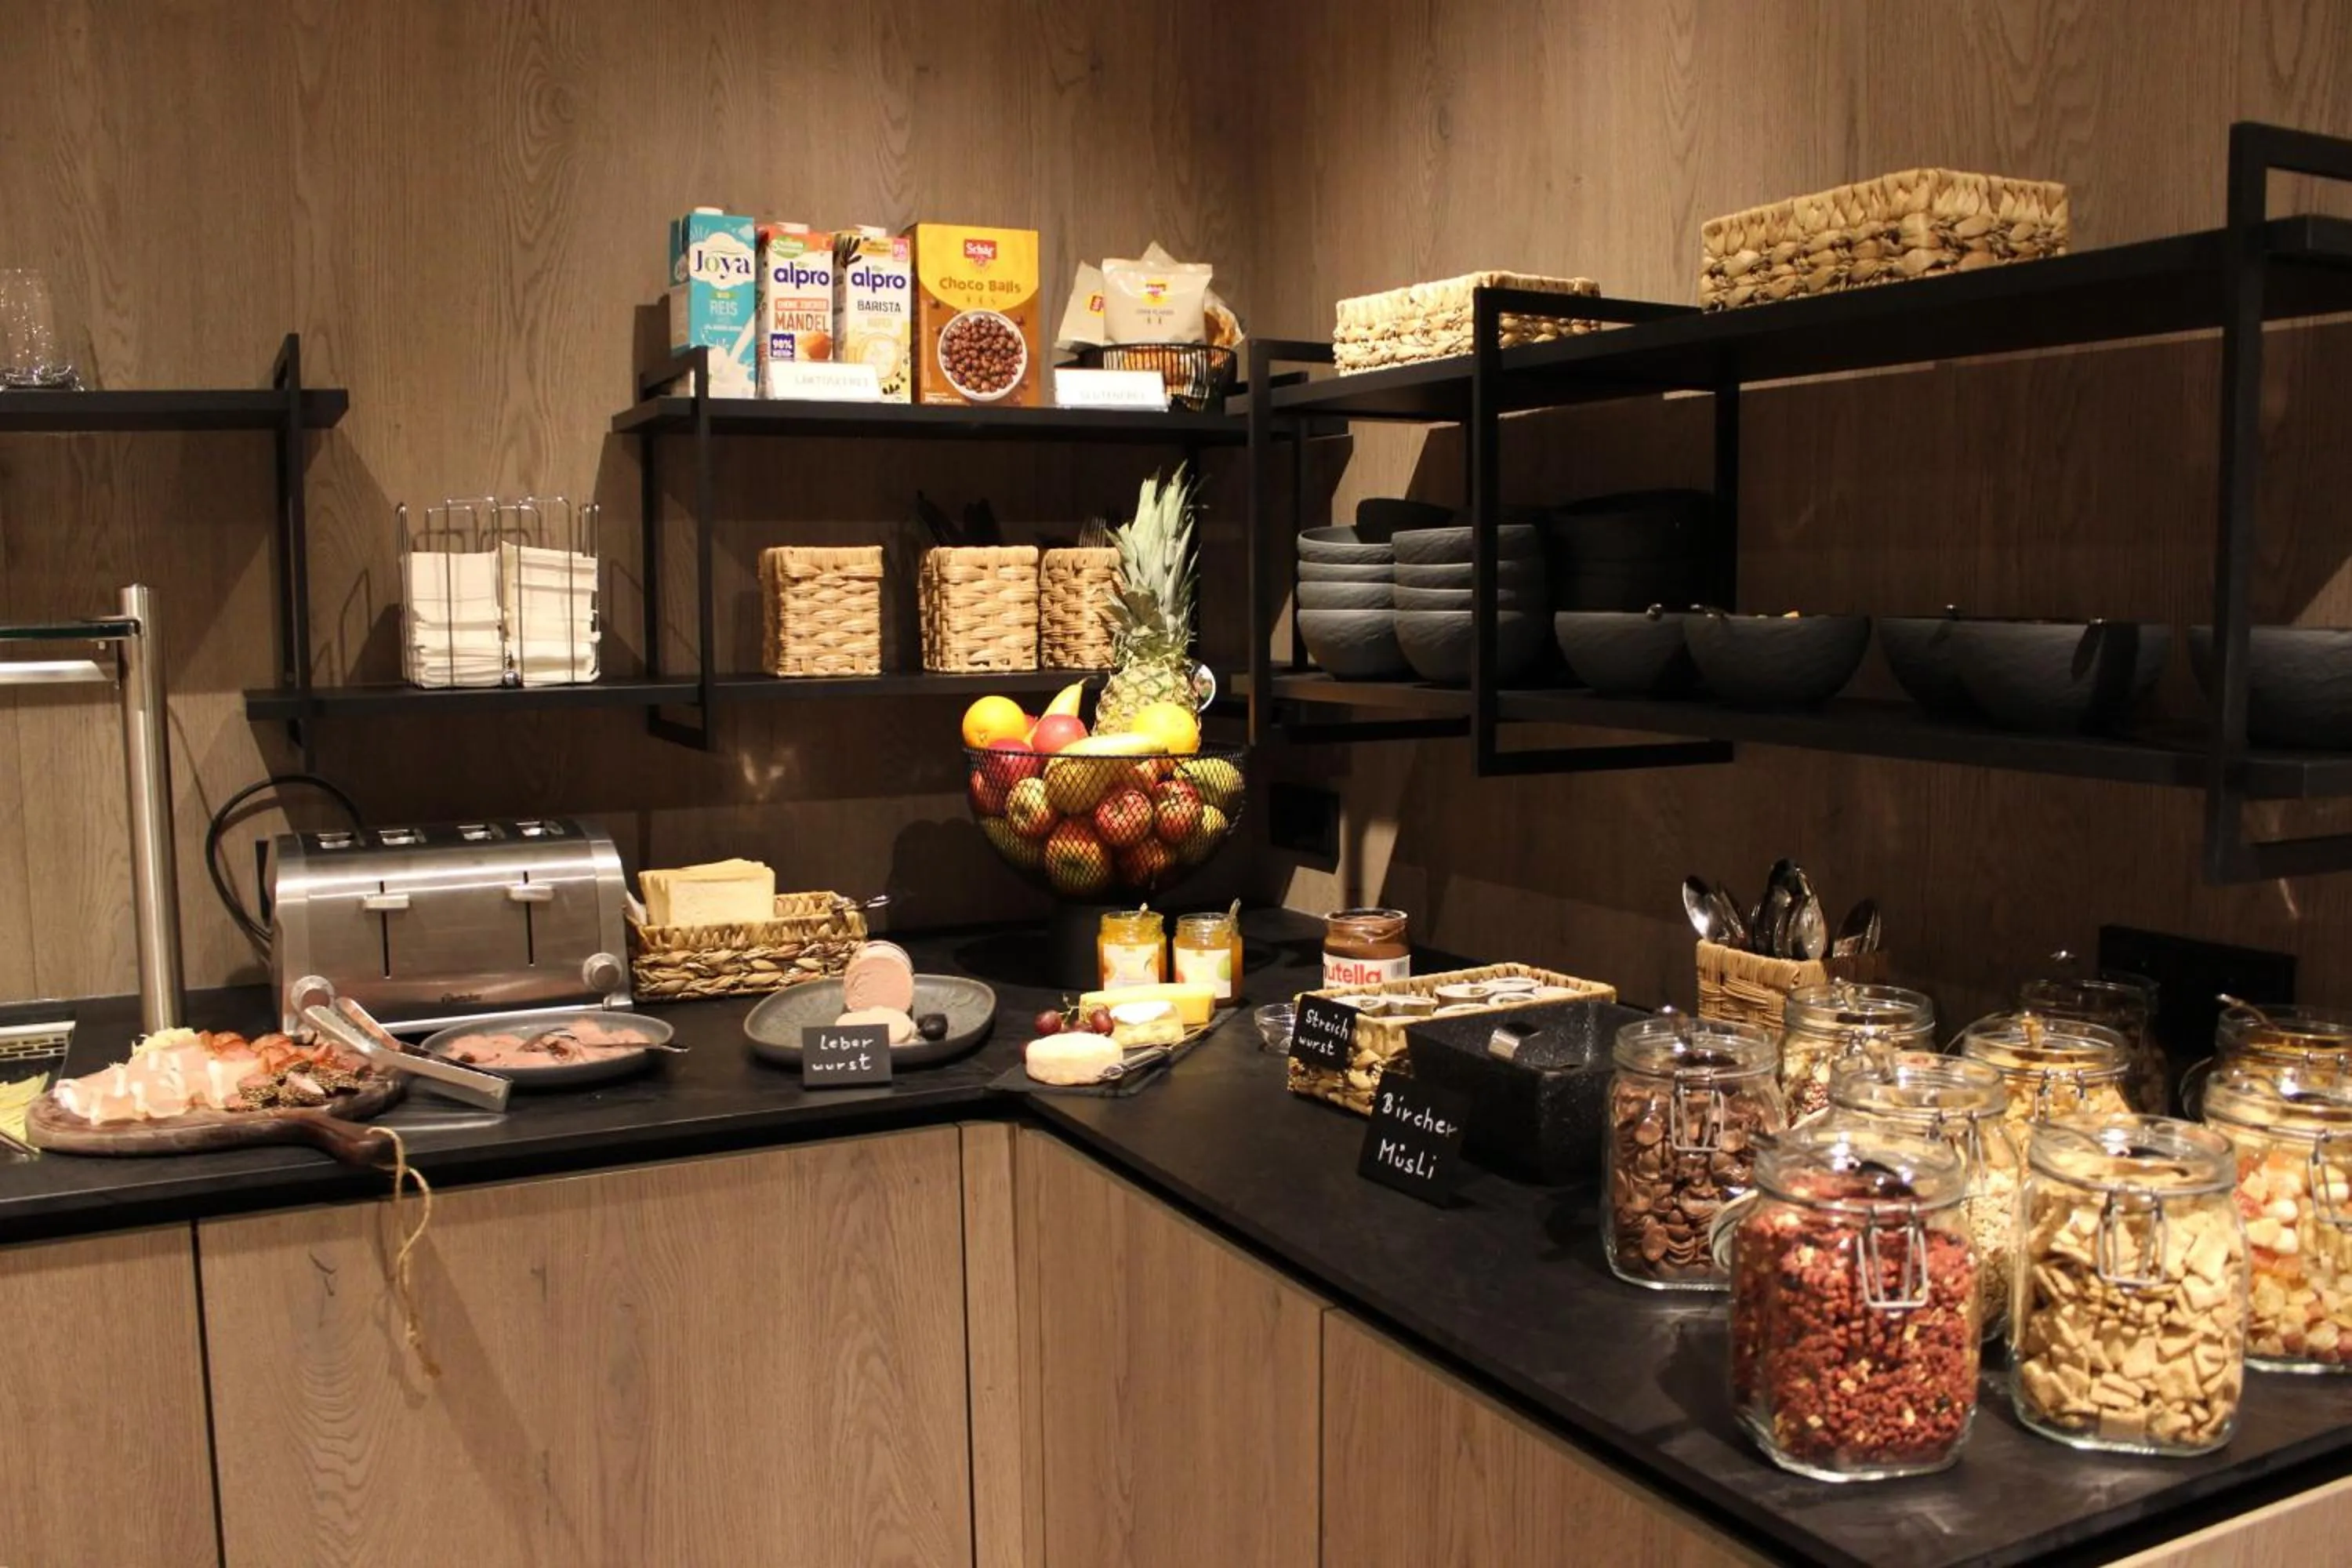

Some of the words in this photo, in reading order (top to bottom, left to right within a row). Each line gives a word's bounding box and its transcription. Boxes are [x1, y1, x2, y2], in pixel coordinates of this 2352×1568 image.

[695, 250, 750, 279] Joya
[774, 261, 829, 289] alpro
[851, 266, 906, 293] alpro
[939, 276, 984, 291] Choco
[989, 280, 1022, 294] Balls
[710, 301, 738, 316] REIS
[857, 299, 901, 313] BARISTA
[775, 312, 829, 332] MANDEL
[1305, 1009, 1348, 1040] Streich
[820, 1034, 874, 1051] Leber
[1298, 1036, 1335, 1056] wurst
[1382, 1092, 1458, 1138] Bircher
